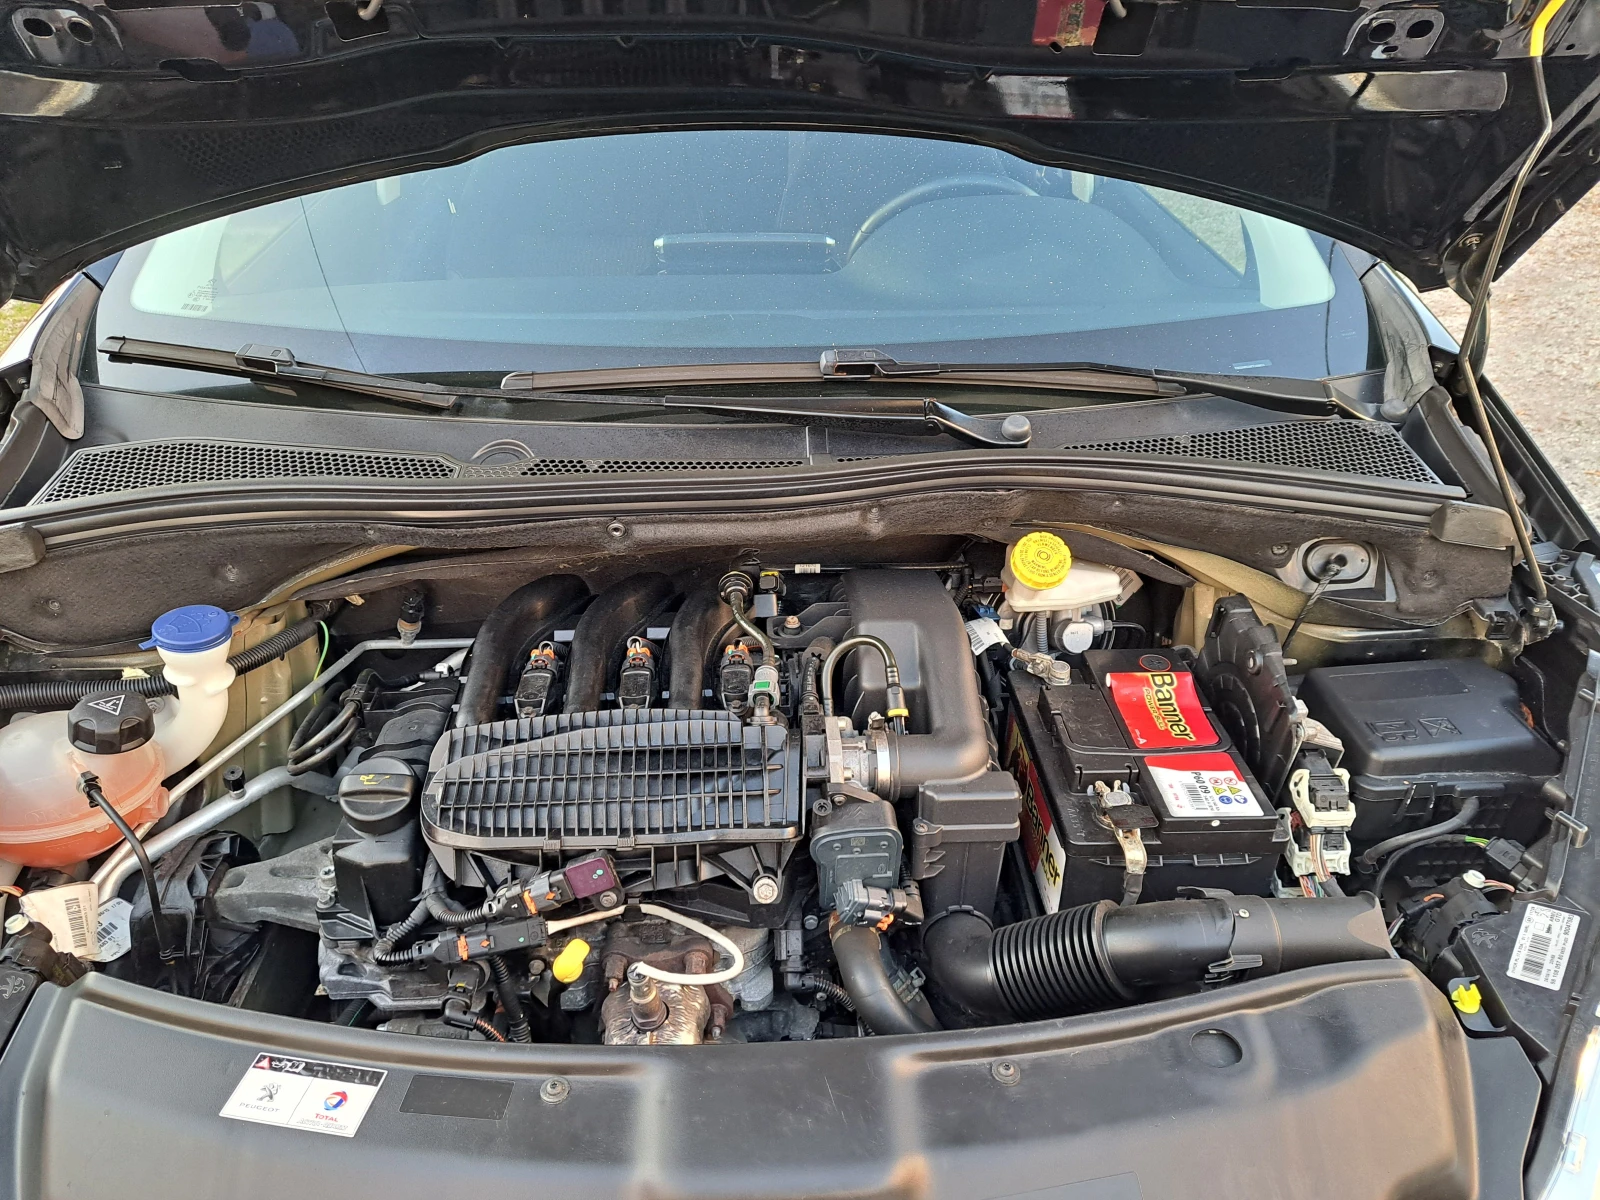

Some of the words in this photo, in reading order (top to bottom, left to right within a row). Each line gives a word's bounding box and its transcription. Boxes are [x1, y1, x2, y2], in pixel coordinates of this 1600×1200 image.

[1144, 688, 1159, 714] POWER
[1149, 672, 1194, 740] Banner
[1191, 771, 1206, 784] P60
[1199, 785, 1211, 794] 09
[1026, 778, 1060, 886] Banner
[239, 1102, 280, 1113] PEUGEOT
[315, 1113, 339, 1123] TOTAL
